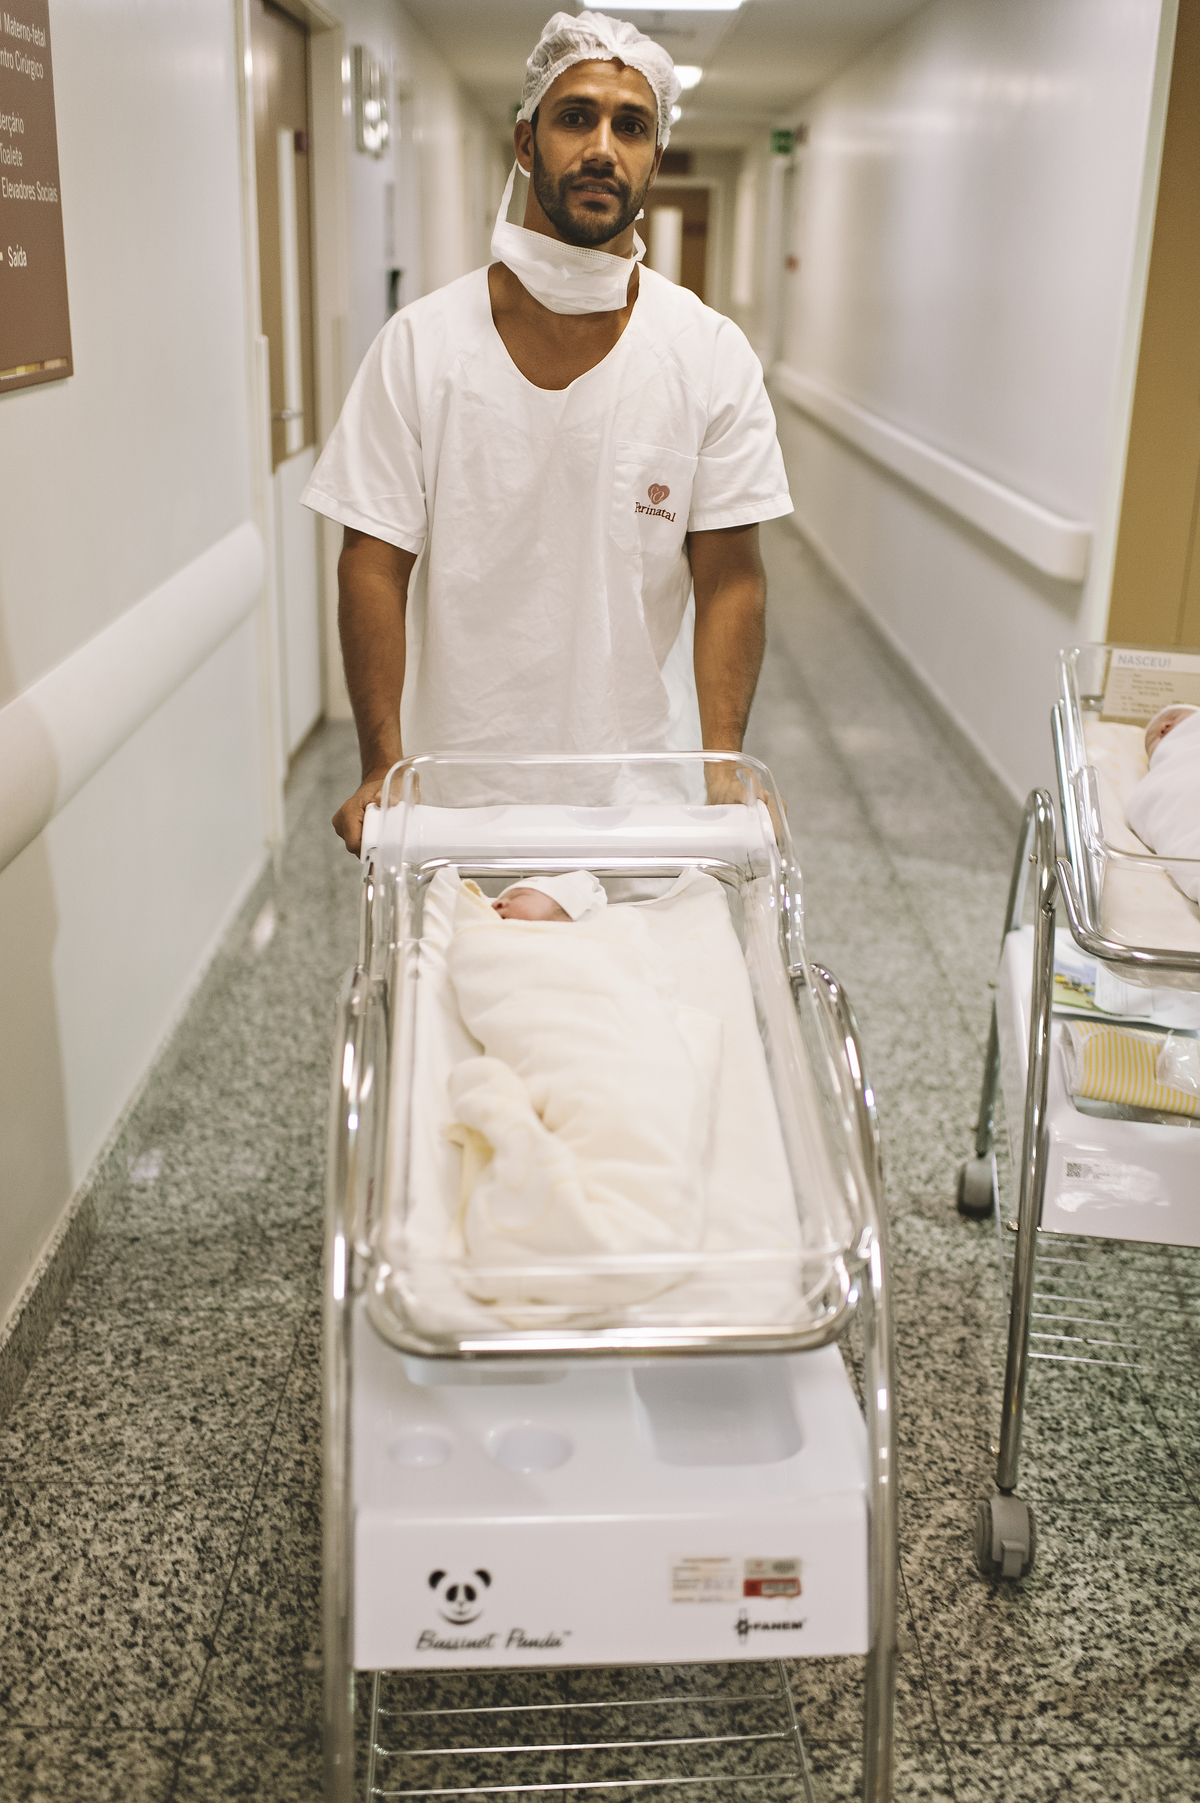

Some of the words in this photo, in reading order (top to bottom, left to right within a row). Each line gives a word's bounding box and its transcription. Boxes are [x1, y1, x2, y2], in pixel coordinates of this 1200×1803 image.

[3, 11, 47, 48] Materno-fetal
[14, 50, 44, 81] Cirúrgico
[1, 176, 36, 201] Elevadores
[36, 180, 58, 203] Sociais
[7, 243, 28, 268] Saída
[1117, 654, 1172, 668] NASCEU!
